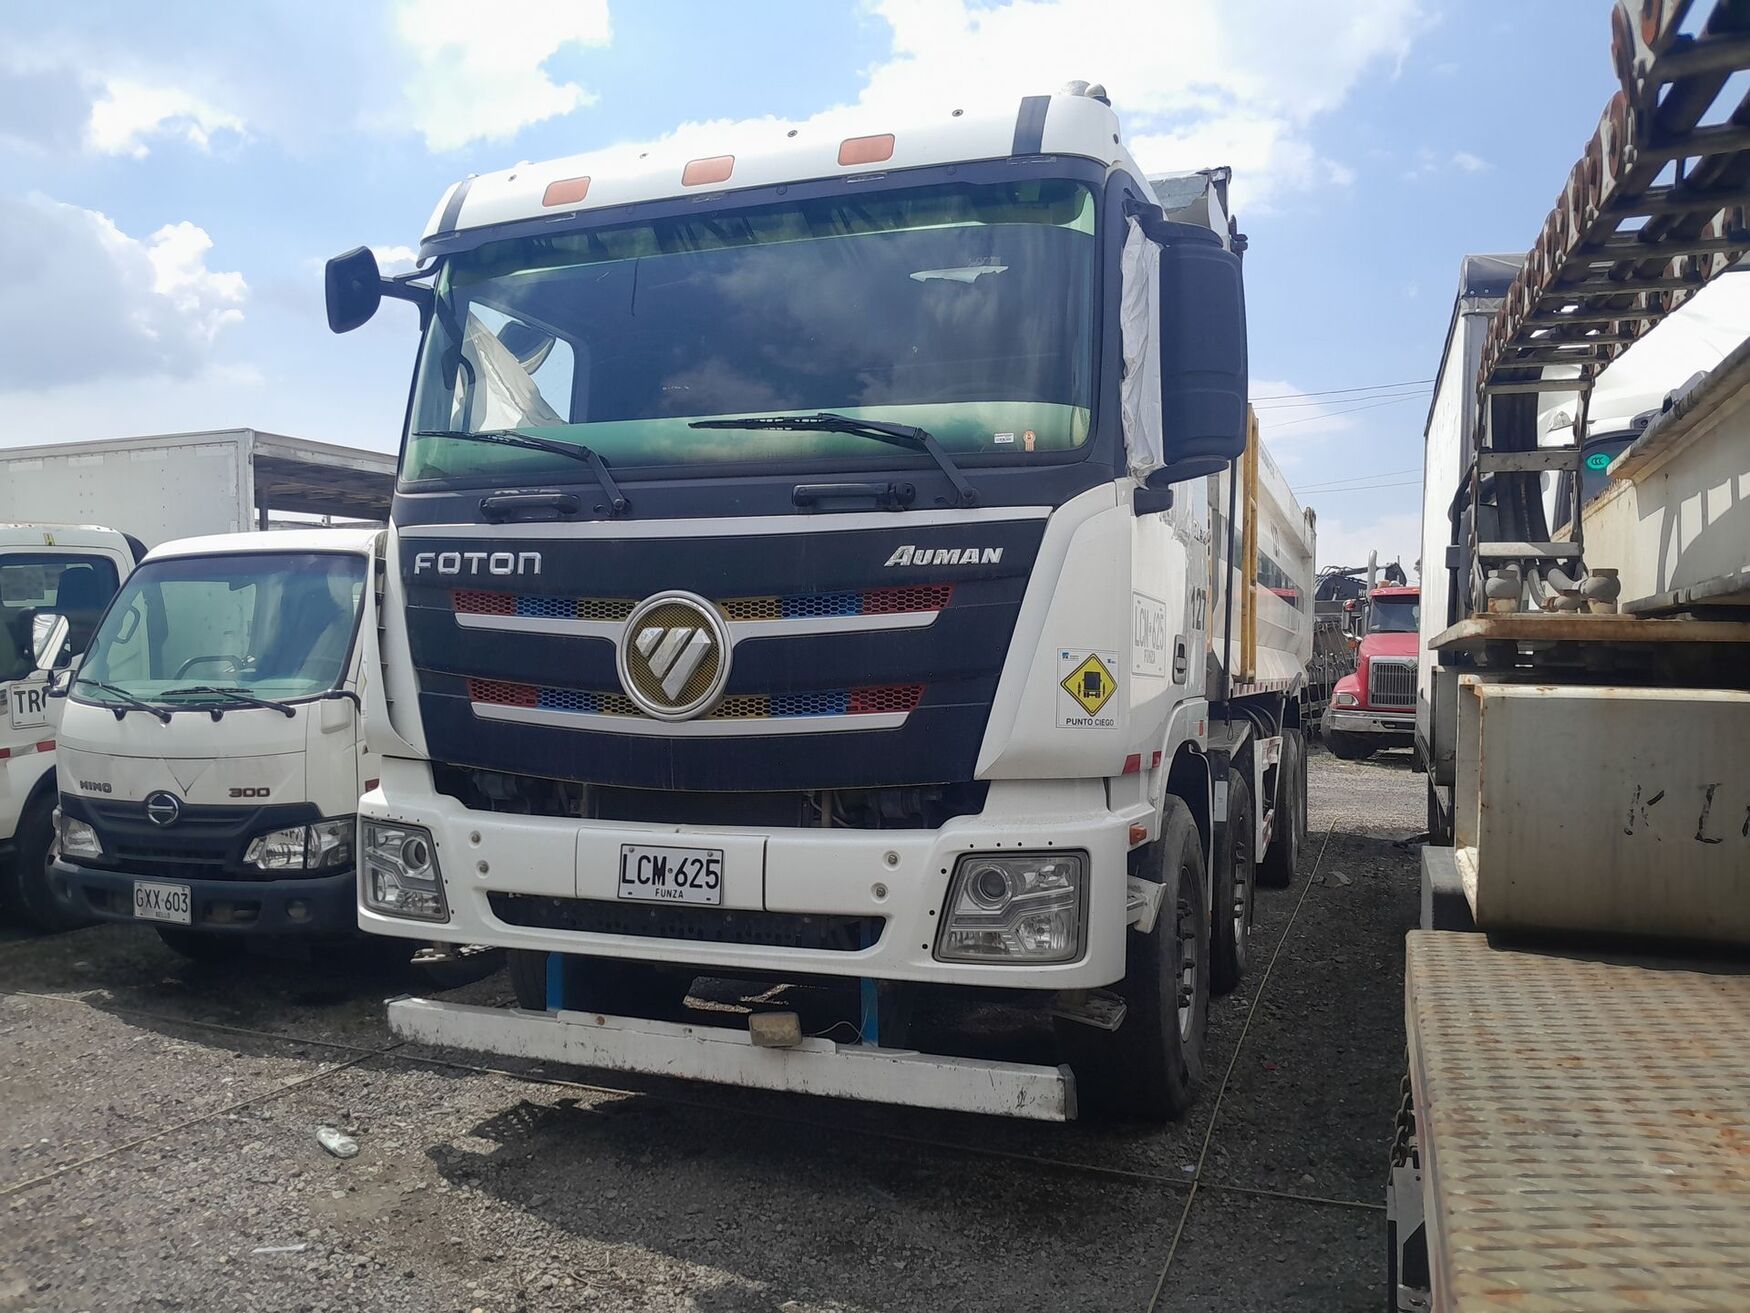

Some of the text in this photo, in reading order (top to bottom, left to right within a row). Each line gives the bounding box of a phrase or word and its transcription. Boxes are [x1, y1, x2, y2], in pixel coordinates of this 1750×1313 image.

[884, 545, 1004, 567] AUMAN
[413, 551, 542, 575] FOTON
[1066, 717, 1115, 726] PUNTO CIEGO
[80, 780, 112, 793] HINO
[228, 787, 271, 798] 300
[655, 888, 684, 899] FUNZA
